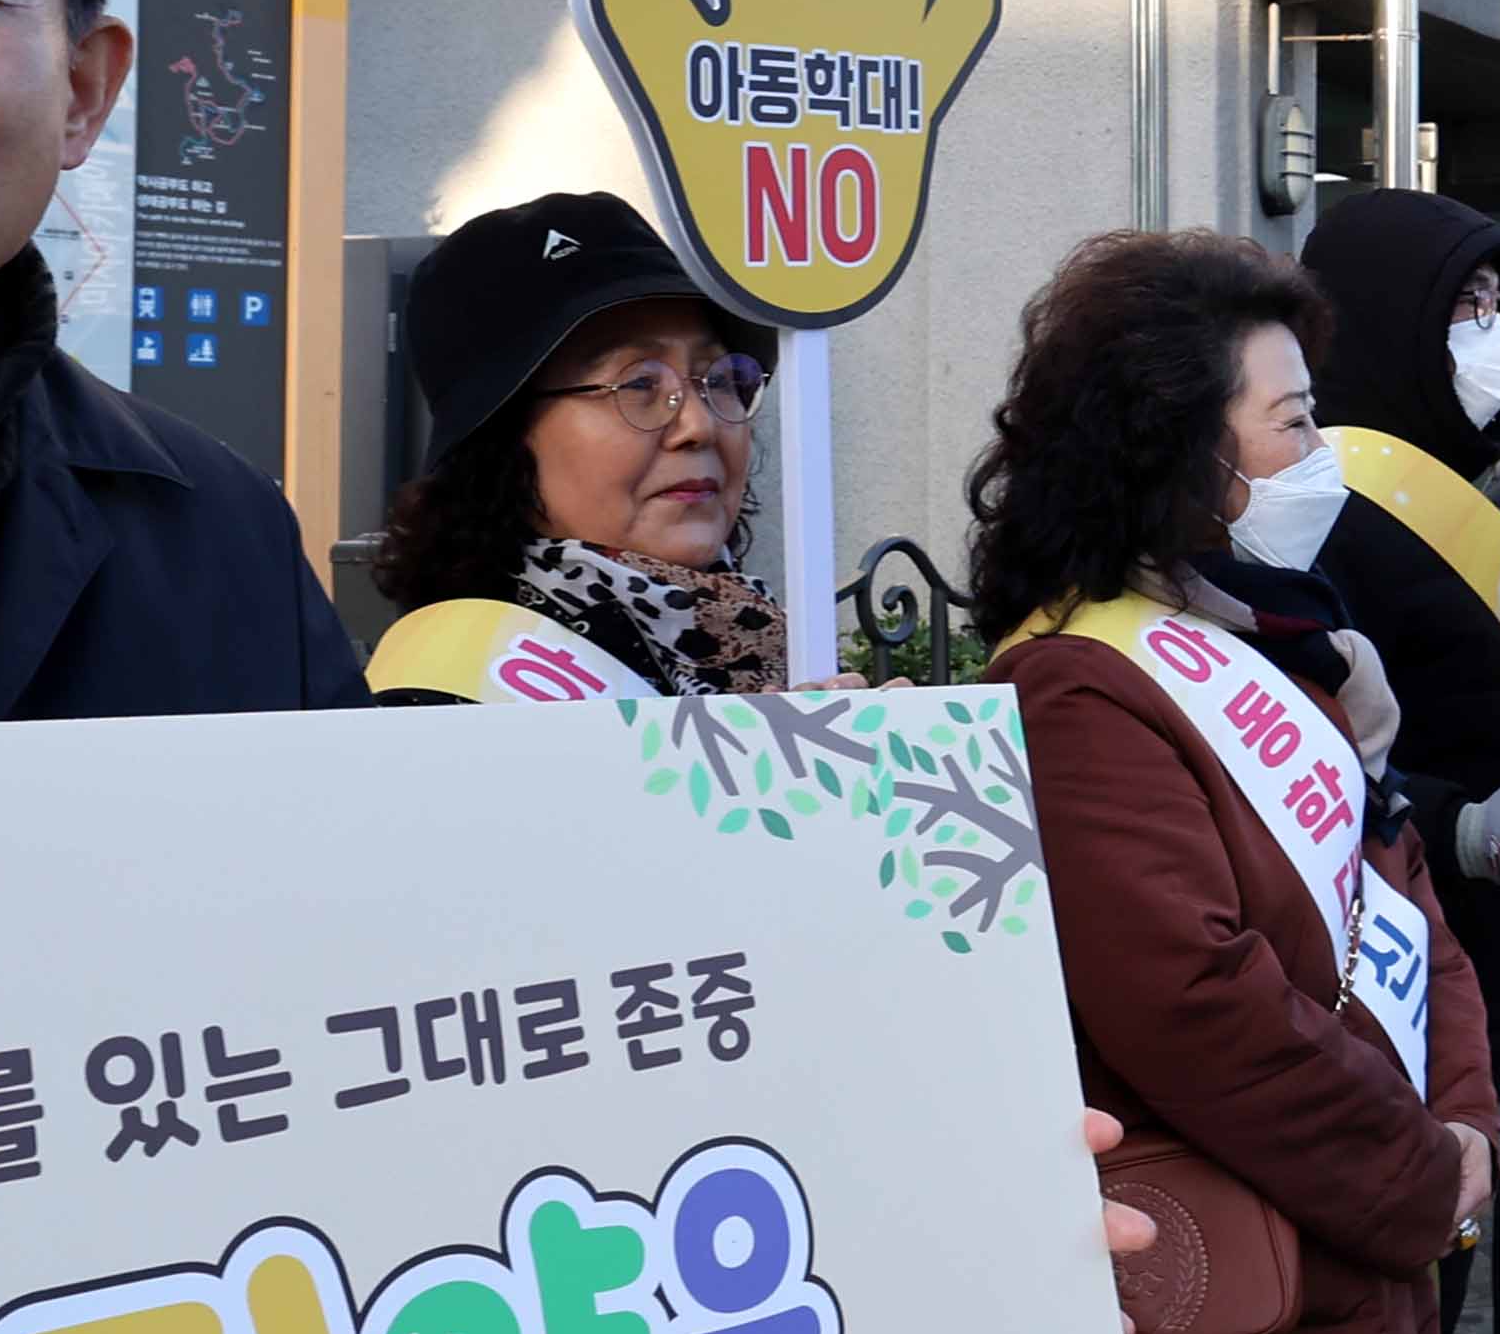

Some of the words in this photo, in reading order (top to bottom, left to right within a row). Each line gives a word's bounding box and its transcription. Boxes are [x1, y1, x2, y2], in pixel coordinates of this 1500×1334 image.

[687, 41, 922, 133] 아동학대!
[746, 144, 878, 265] NO
[84, 1024, 292, 1164] 있는
[322, 977, 590, 1110] 그대로
[610, 951, 756, 1072] 존중
